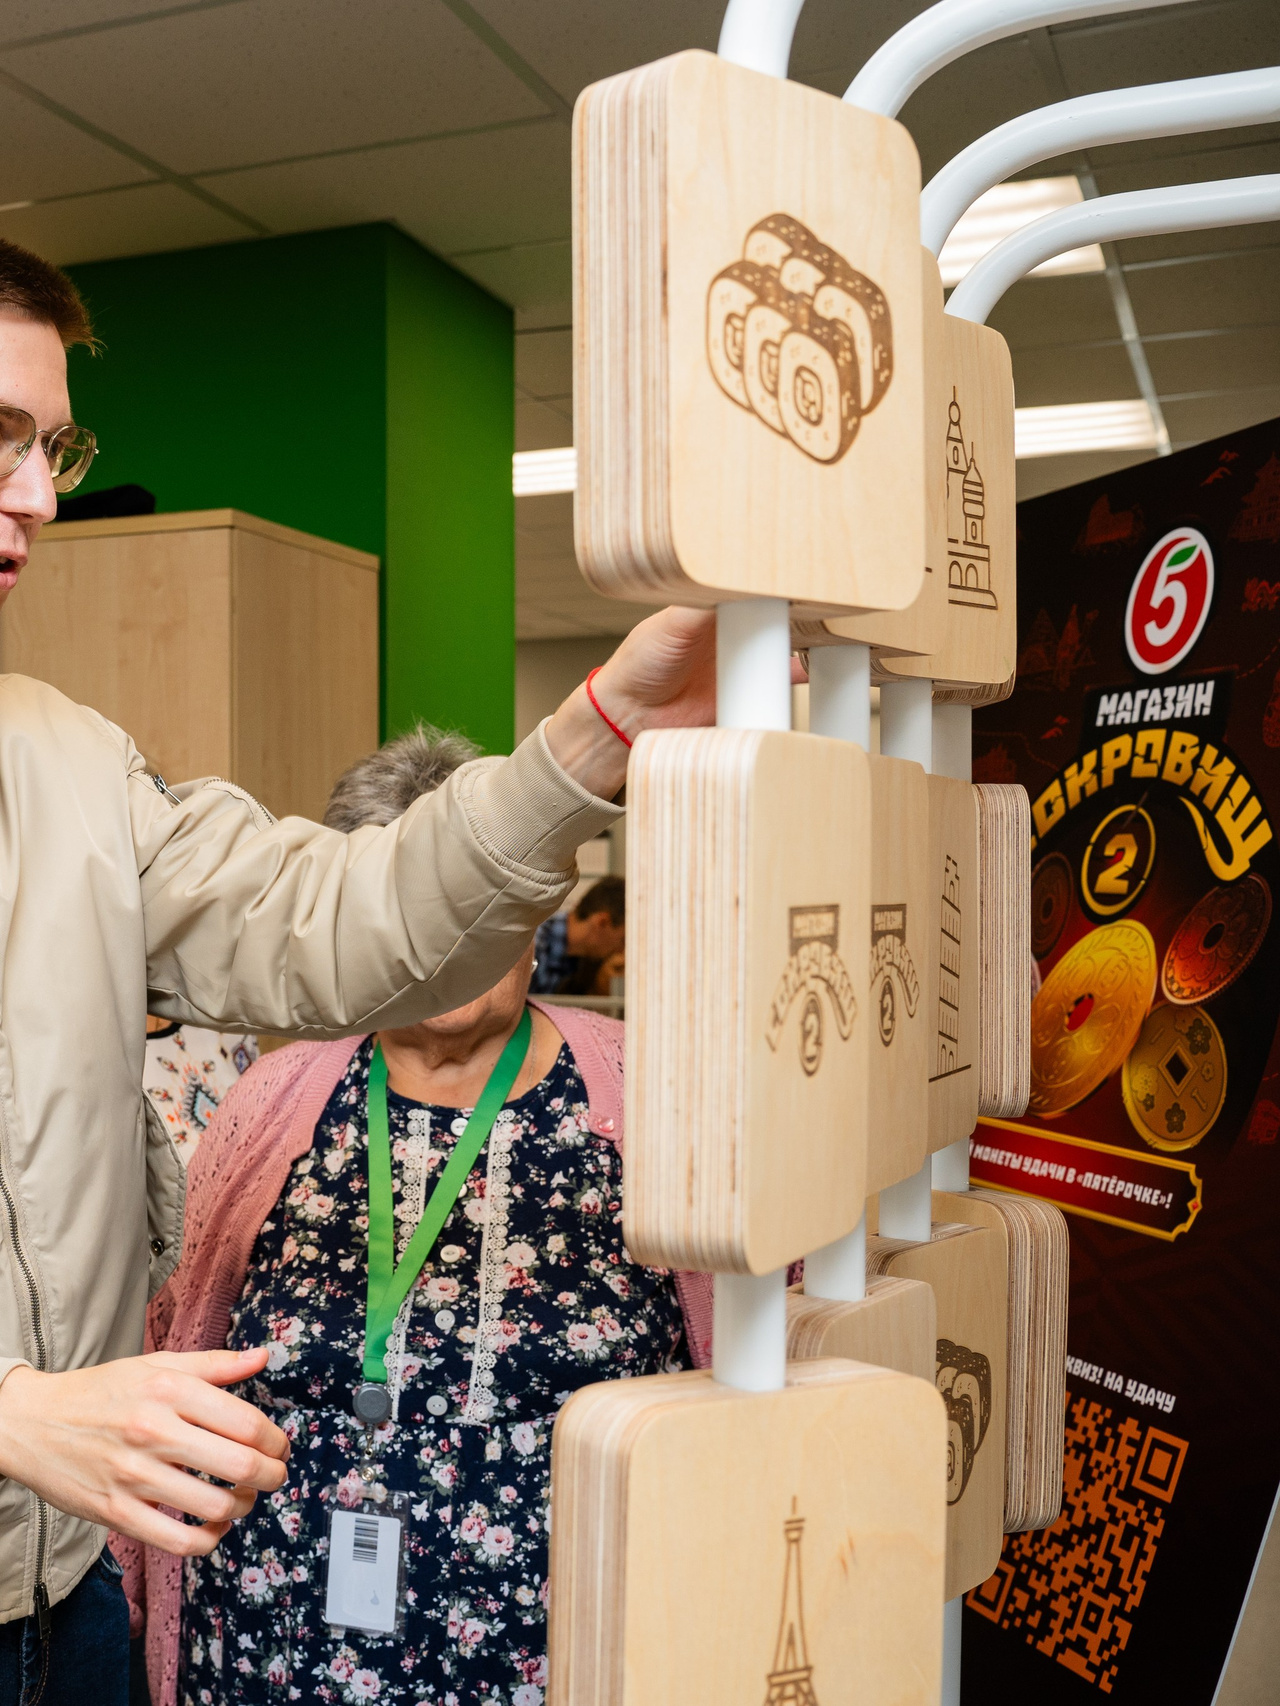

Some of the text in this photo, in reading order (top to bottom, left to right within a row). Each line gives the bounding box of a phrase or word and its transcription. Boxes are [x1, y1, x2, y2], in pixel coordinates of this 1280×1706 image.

[1144, 548, 1192, 646] 5
[1095, 681, 1215, 727] МАГАЗИН
[1031, 729, 1273, 881] ОКРОВИЩ
[1094, 834, 1138, 895] 2
[973, 1144, 1023, 1170] МОНЕТЫ
[1022, 1156, 1066, 1182] УДАЧИ
[1065, 1167, 1077, 1184] В
[1103, 1371, 1123, 1393] НА
[1125, 1379, 1176, 1414] УДАЧУ
